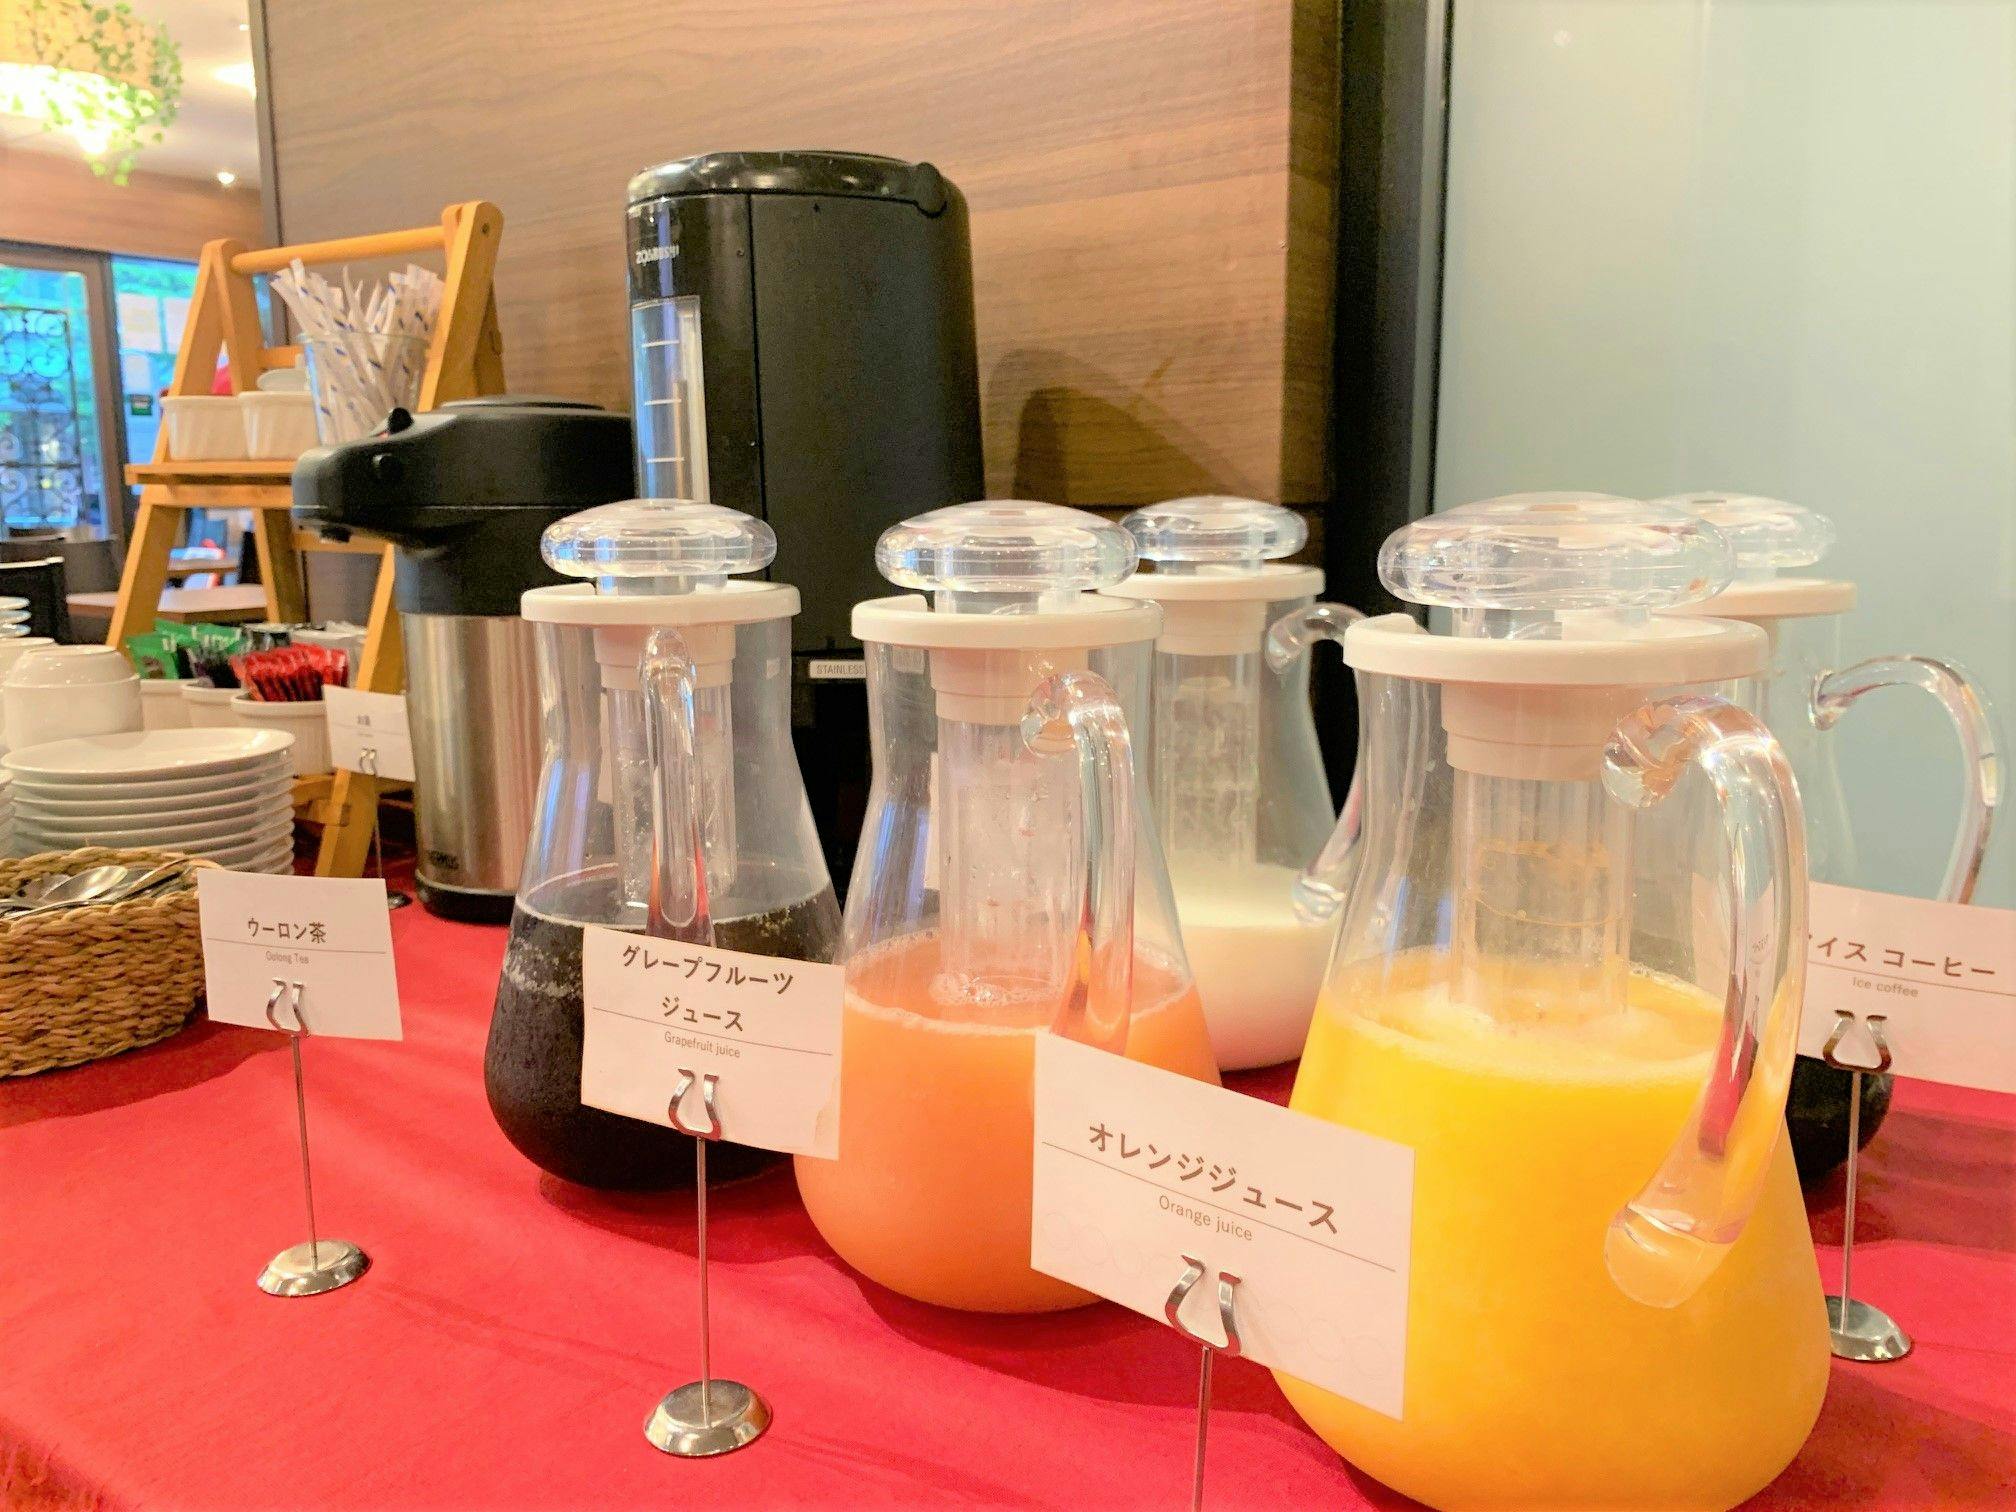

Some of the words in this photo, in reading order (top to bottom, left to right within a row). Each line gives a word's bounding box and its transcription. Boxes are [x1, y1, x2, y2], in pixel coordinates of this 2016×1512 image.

[816, 664, 865, 675] STAINLESS
[247, 917, 326, 943] ウーロン茶
[265, 950, 292, 964] Oolong
[294, 953, 309, 964] Tea
[622, 944, 794, 995] グレープフルーツ
[1808, 933, 1867, 962] イス
[1883, 948, 1996, 978] コーヒー
[1853, 976, 1872, 988] Ice
[1876, 982, 1919, 998] coffee
[662, 996, 744, 1032] ジュース
[664, 1031, 713, 1054] Grapefruit
[714, 1043, 741, 1058] juice
[1089, 1123, 1338, 1235] オレンジジュース
[1158, 1194, 1212, 1227] Orange
[1215, 1215, 1253, 1242] juice
